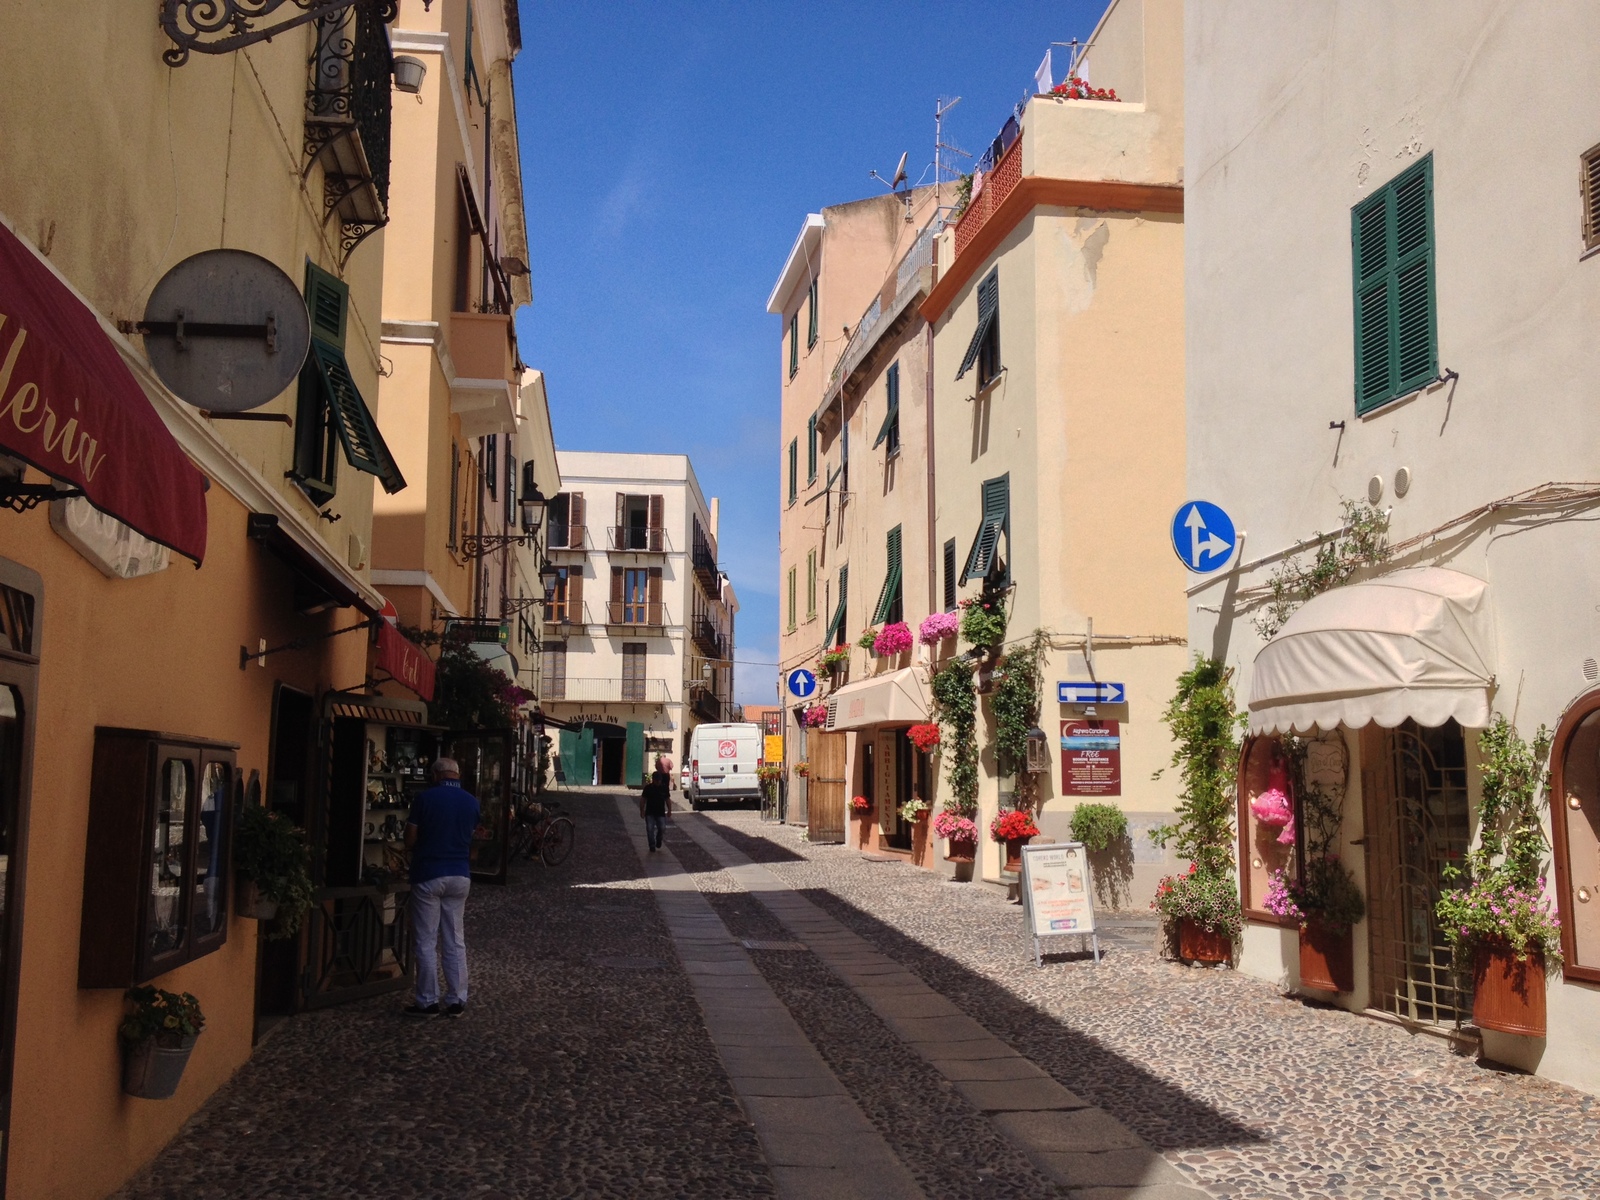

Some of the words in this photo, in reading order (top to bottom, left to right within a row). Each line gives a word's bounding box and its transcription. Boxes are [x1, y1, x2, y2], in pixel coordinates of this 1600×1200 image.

[0, 313, 106, 482] leria
[568, 713, 603, 724] JAMAICA
[606, 714, 620, 724] INN
[1080, 750, 1100, 758] FREE
